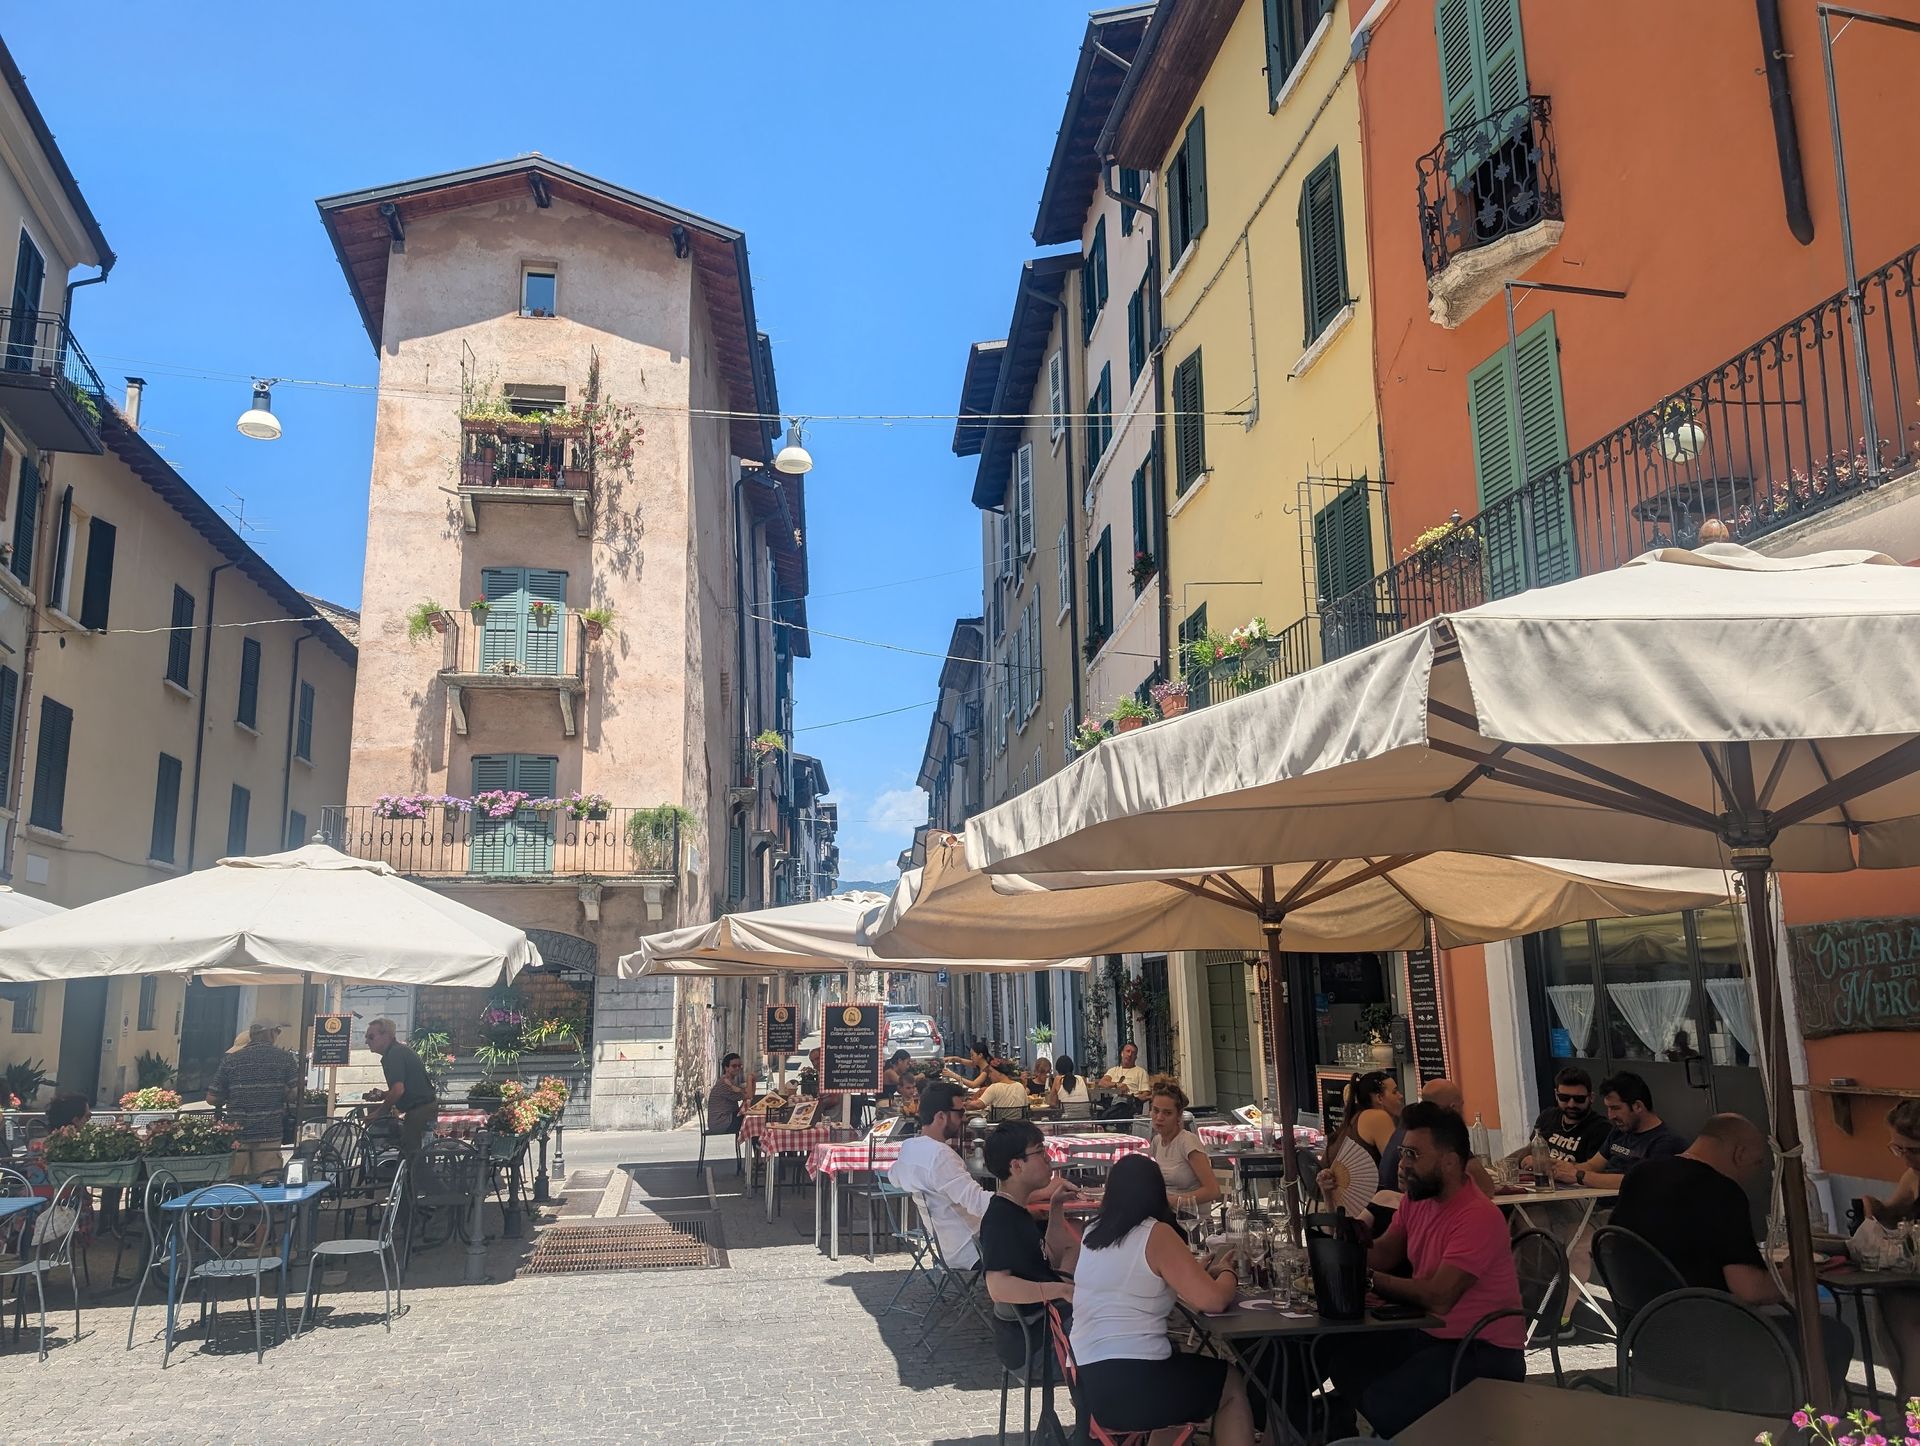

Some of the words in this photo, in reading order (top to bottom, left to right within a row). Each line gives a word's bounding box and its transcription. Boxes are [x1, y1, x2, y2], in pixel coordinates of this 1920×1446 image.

[1809, 927, 1920, 979] OSTERIA
[938, 972, 946, 982] P
[1548, 1133, 1582, 1151] anti
